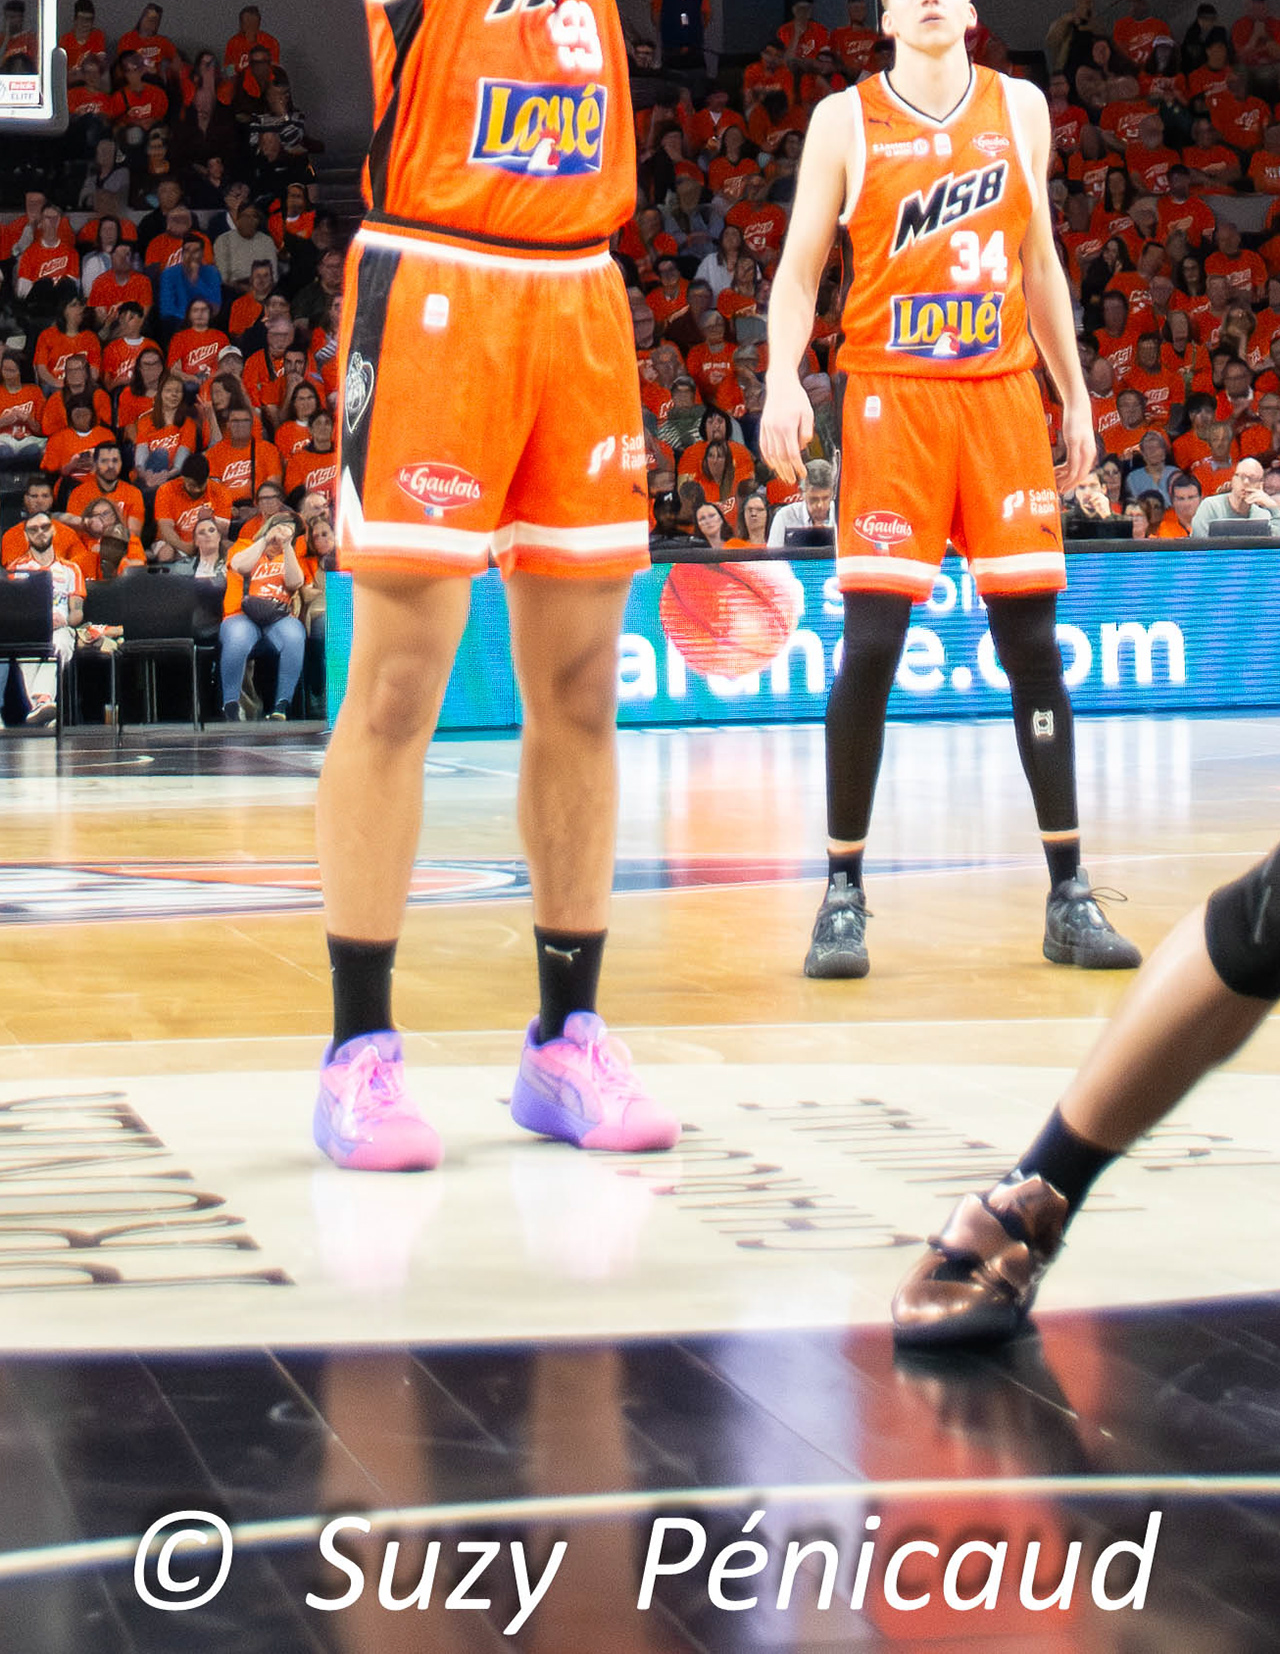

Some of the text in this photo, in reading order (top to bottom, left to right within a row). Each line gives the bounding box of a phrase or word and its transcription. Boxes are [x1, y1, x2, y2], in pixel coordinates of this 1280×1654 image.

[482, 82, 601, 158] Loué
[889, 159, 1010, 259] MSB
[950, 230, 1008, 283] 34
[897, 291, 999, 345] Loué
[410, 467, 481, 499] Gaulois
[862, 515, 913, 537] Gaulois
